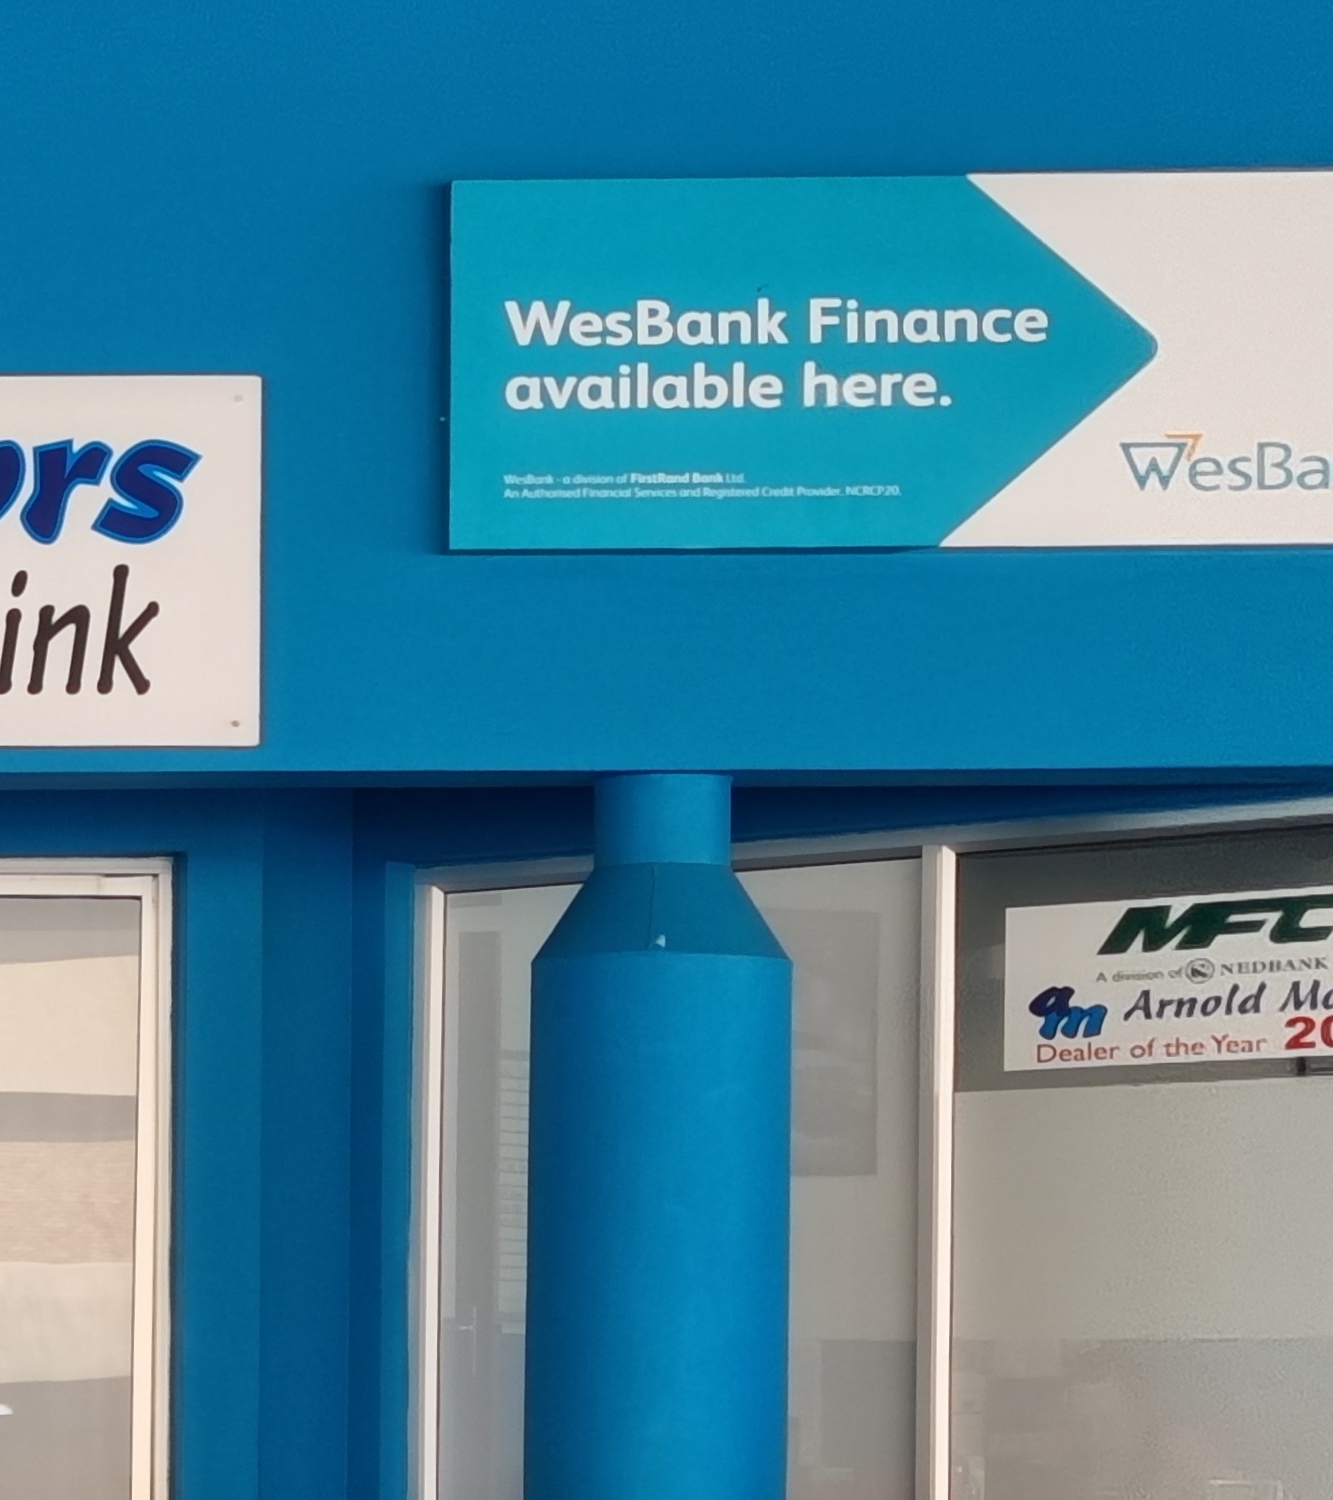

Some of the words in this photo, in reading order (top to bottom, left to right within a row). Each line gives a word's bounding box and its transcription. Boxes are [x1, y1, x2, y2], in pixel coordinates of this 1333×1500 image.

[505, 298, 787, 346] WesBank
[808, 296, 1048, 344] Finance
[505, 362, 783, 410] available
[803, 361, 953, 409] here.
[503, 474, 553, 485] WesBank
[573, 473, 613, 485] division
[616, 473, 629, 484] of
[630, 472, 689, 484] FirstRand
[692, 472, 723, 484] Bank
[503, 488, 519, 498] An
[583, 487, 631, 498] Financial
[634, 487, 678, 498] Services
[679, 487, 701, 497] and
[762, 486, 794, 497] Credit
[1097, 894, 1333, 955] MFC
[1096, 971, 1107, 982] A
[1112, 969, 1164, 982] division
[1168, 967, 1183, 979] of
[1220, 957, 1328, 976] NEDBANK
[1123, 981, 1266, 1021] Arnold
[1036, 1042, 1121, 1063] Dealer
[1130, 1038, 1158, 1059] of
[1163, 1038, 1205, 1057] the
[1211, 1034, 1268, 1055] Year
